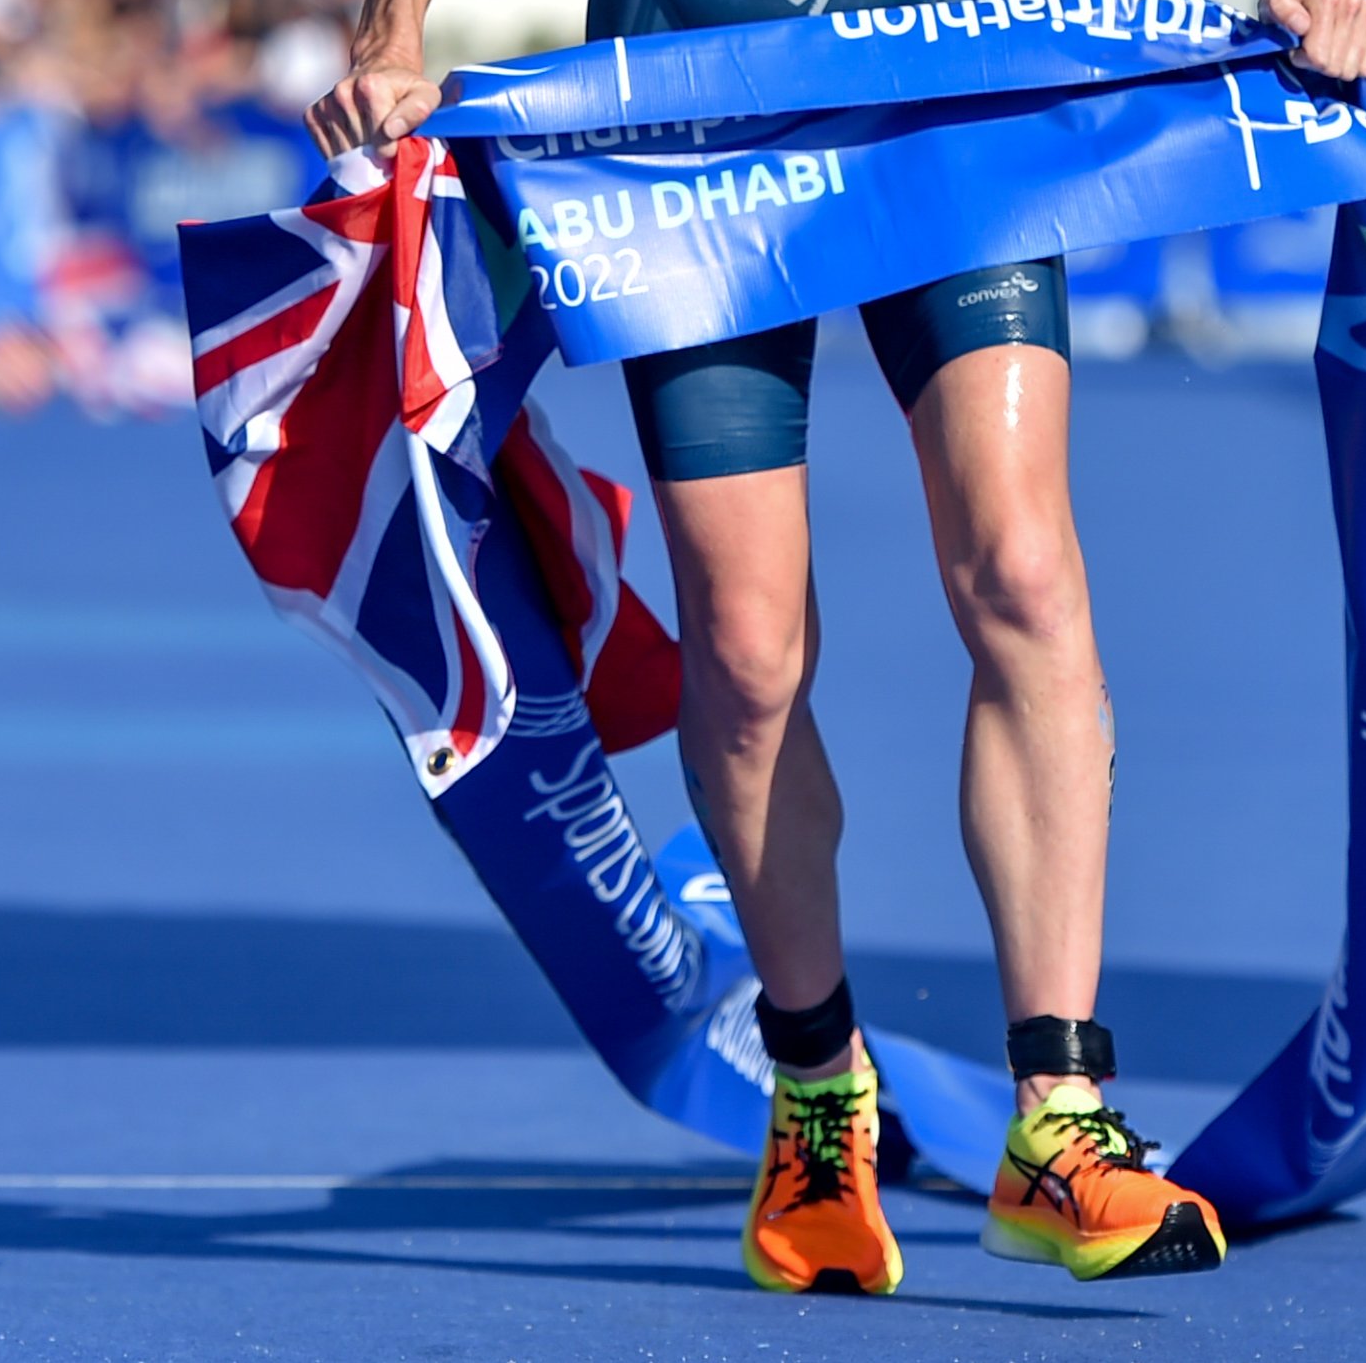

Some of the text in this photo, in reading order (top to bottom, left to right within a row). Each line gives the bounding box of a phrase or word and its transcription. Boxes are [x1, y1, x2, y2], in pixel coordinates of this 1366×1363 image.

[517, 148, 846, 253] ABU DHABI
[529, 247, 650, 311] 2022
